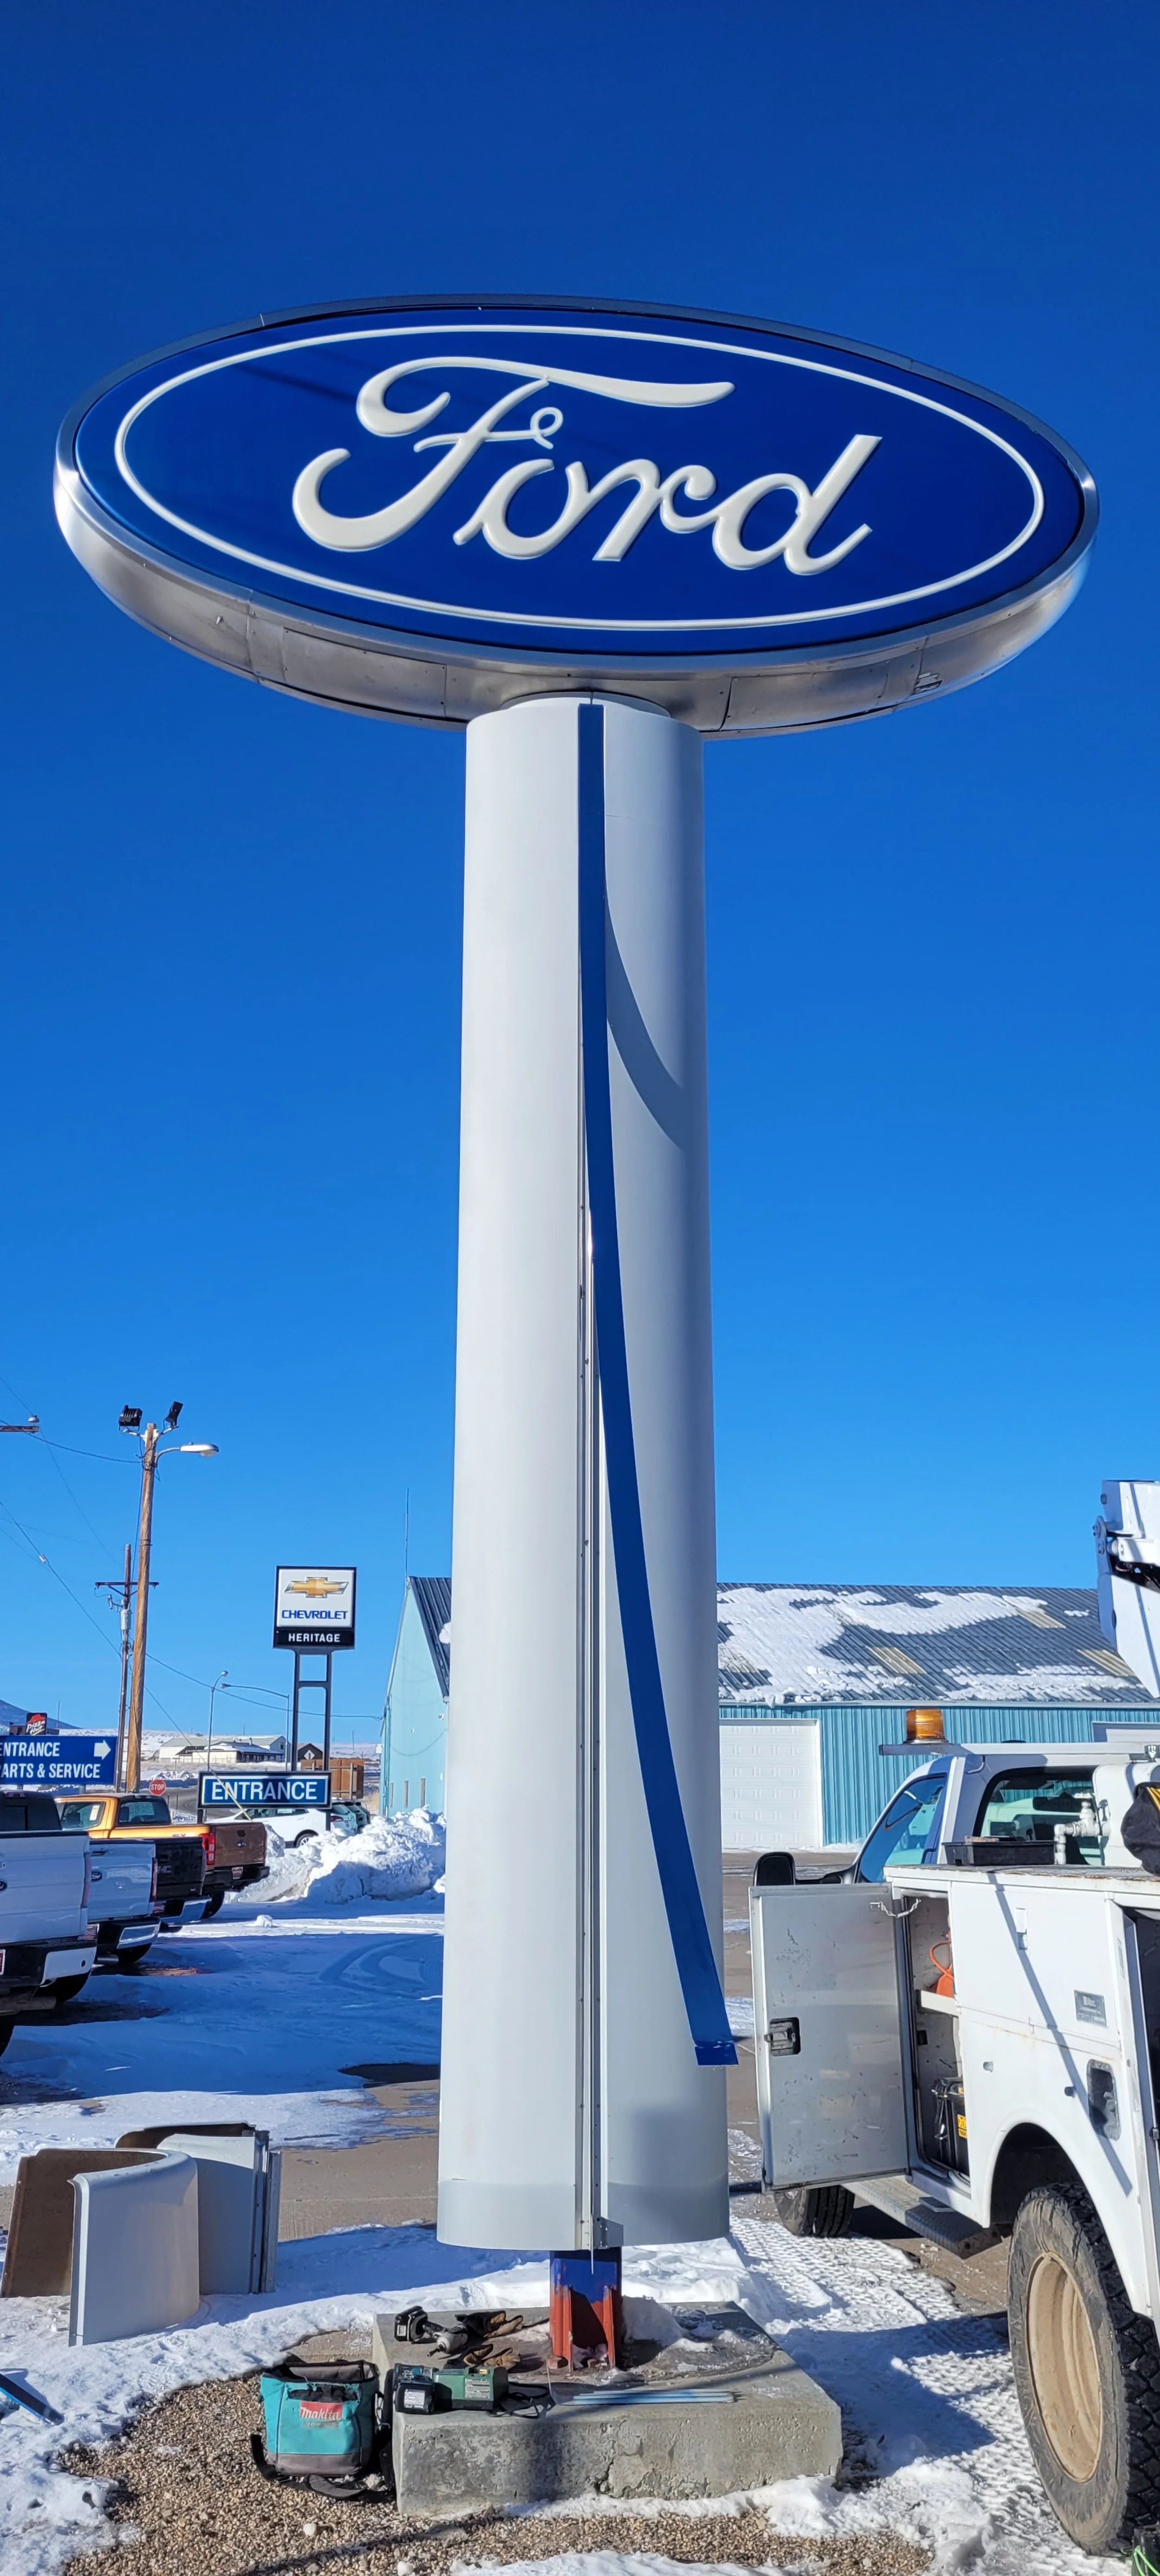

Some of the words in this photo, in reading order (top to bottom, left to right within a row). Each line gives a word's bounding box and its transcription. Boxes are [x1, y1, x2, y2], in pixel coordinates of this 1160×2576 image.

[292, 356, 883, 575] Ford
[282, 1610, 348, 1620] CHEVROLET
[288, 1633, 340, 1642] HERITAGE
[26, 1720, 45, 1733] Pizza
[0, 1763, 34, 1778] ARTS
[37, 1763, 45, 1778] &
[49, 1763, 101, 1778] SERVICE
[212, 1782, 317, 1800] ENTRANCE
